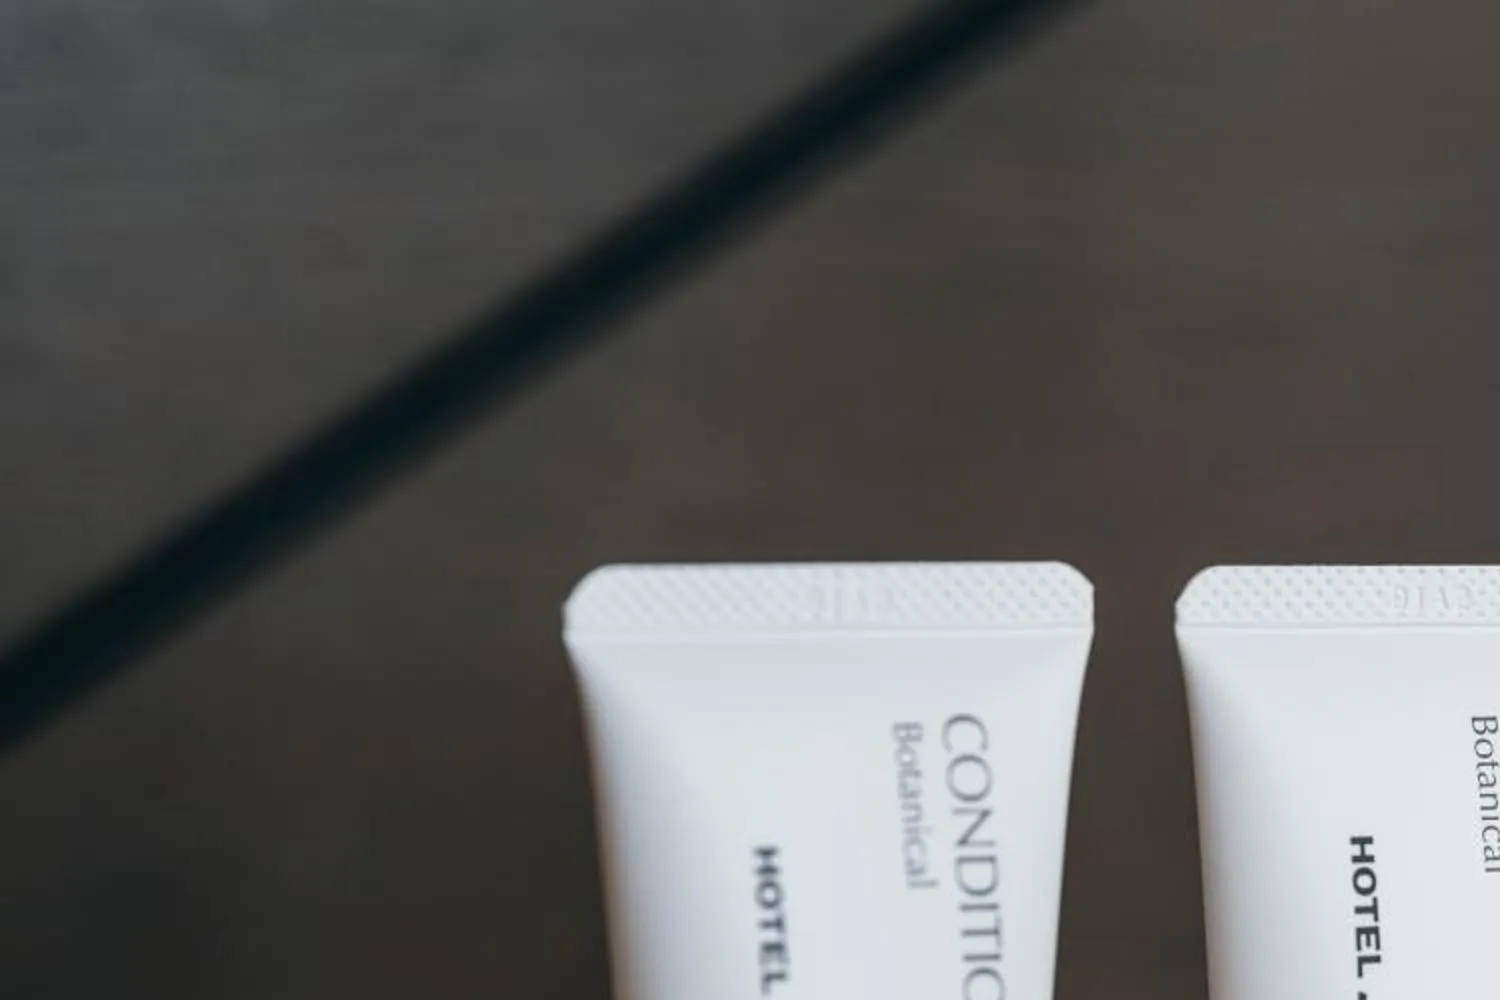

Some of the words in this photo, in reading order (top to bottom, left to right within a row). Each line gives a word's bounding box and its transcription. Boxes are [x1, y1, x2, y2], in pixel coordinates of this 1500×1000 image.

[892, 722, 938, 889] Botanical
[753, 846, 789, 995] HOTEL
[1350, 836, 1382, 979] HOTEL
